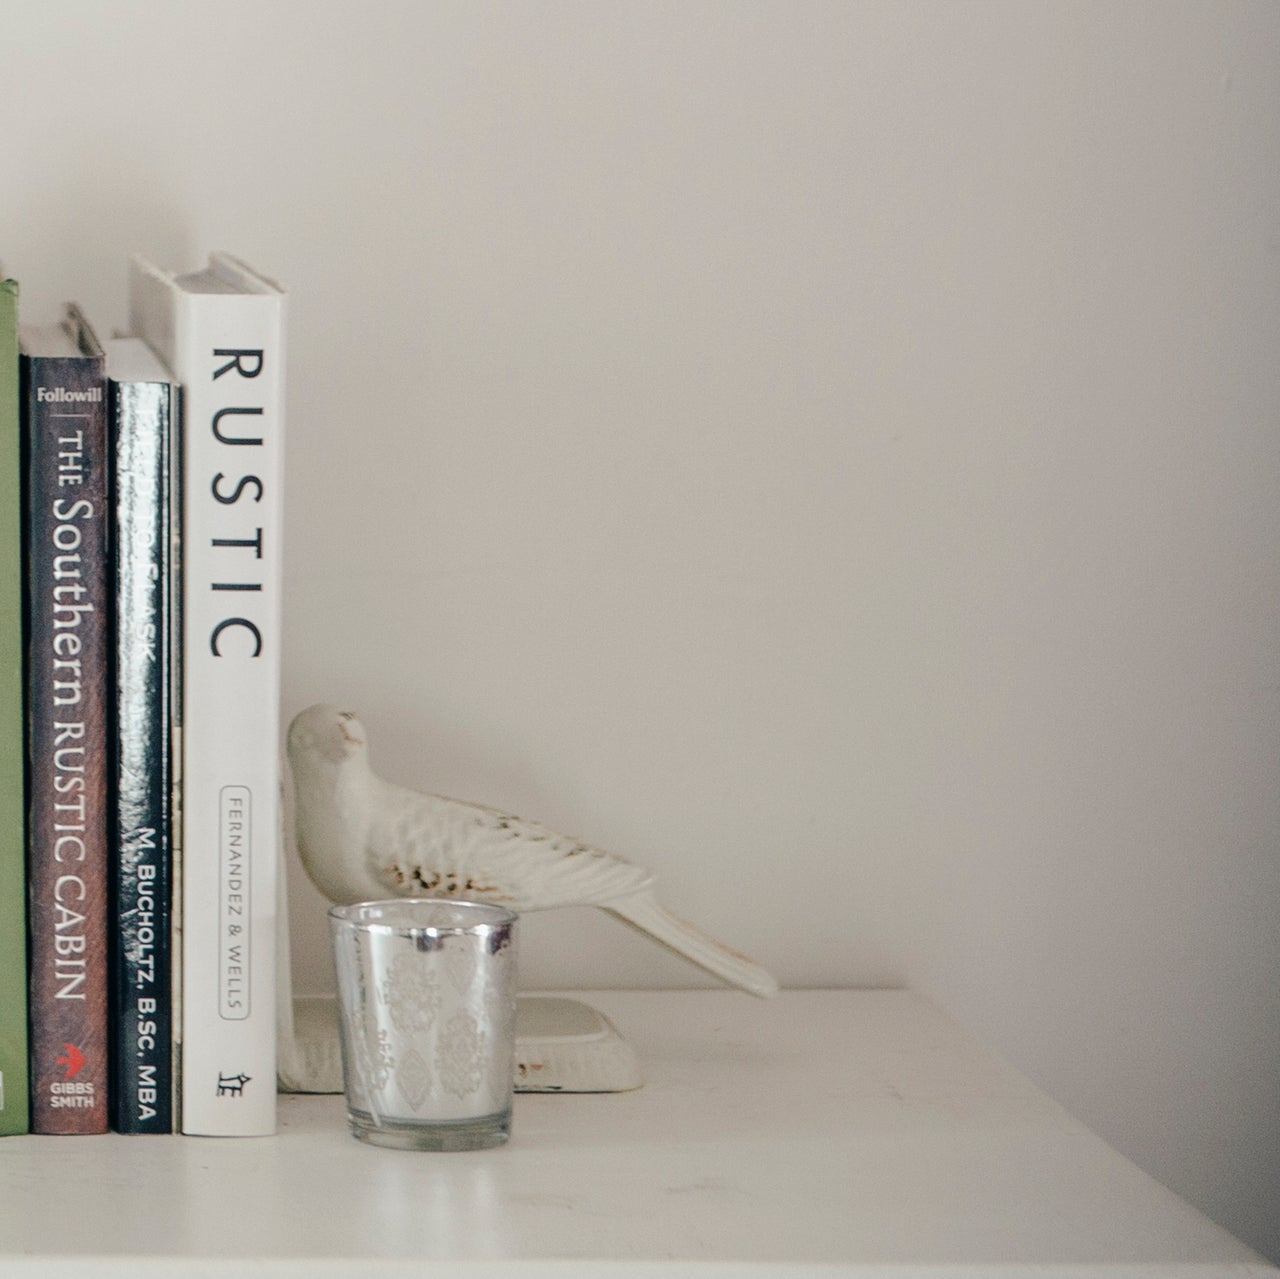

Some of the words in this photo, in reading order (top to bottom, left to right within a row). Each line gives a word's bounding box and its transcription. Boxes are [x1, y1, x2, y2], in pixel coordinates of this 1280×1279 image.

[37, 387, 102, 403] Followill
[57, 429, 83, 488] THE
[211, 348, 265, 659] RUSTIC
[52, 499, 94, 706] Southern
[53, 721, 86, 862] RUSTIC
[136, 827, 156, 857] M.
[227, 796, 243, 917] FERNANDEZ
[53, 874, 87, 1002] CABIN
[134, 864, 156, 990] BUCHOLTZ,
[227, 925, 243, 937] &
[227, 945, 243, 1010] WELLS
[50, 1082, 95, 1095] GIBBS
[50, 1095, 95, 1109] SMITH
[137, 1066, 157, 1120] MBA
